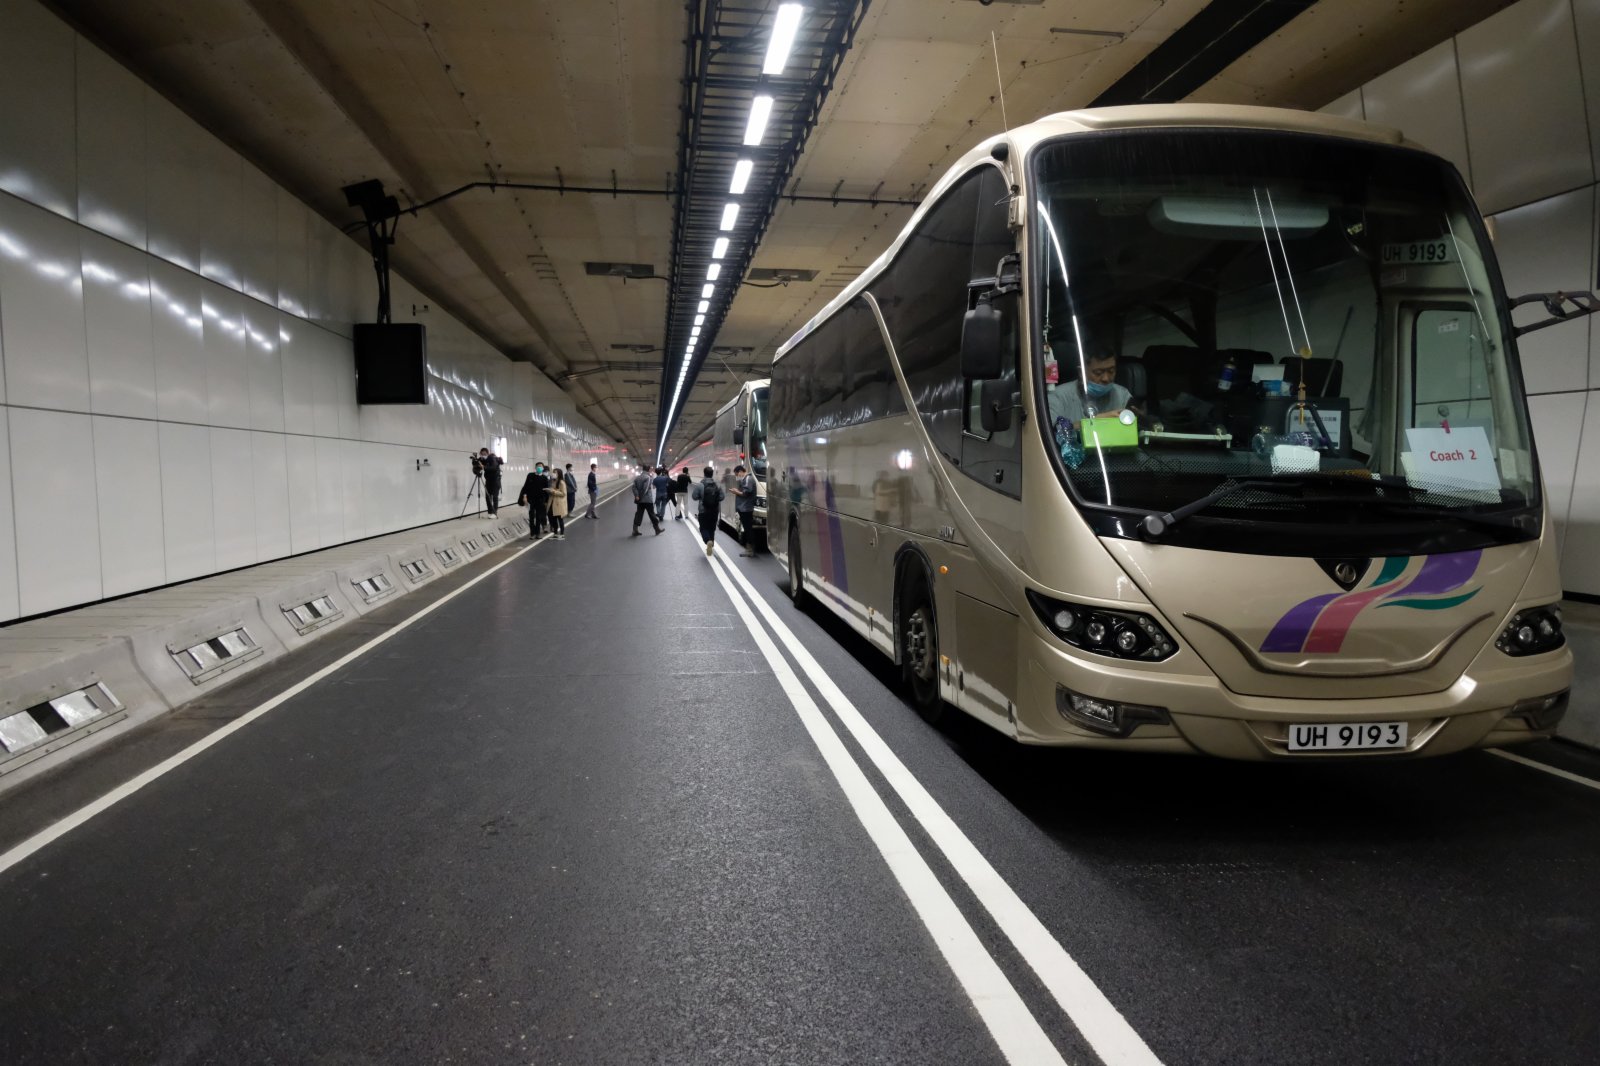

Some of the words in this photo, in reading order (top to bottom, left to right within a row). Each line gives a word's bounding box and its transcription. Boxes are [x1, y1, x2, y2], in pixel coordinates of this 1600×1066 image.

[1383, 245, 1401, 261] UH
[1409, 243, 1446, 261] 9193
[1429, 449, 1464, 462] Coach
[1468, 449, 1477, 460] 2
[1296, 726, 1328, 747] UH
[1339, 725, 1400, 746] 9193
